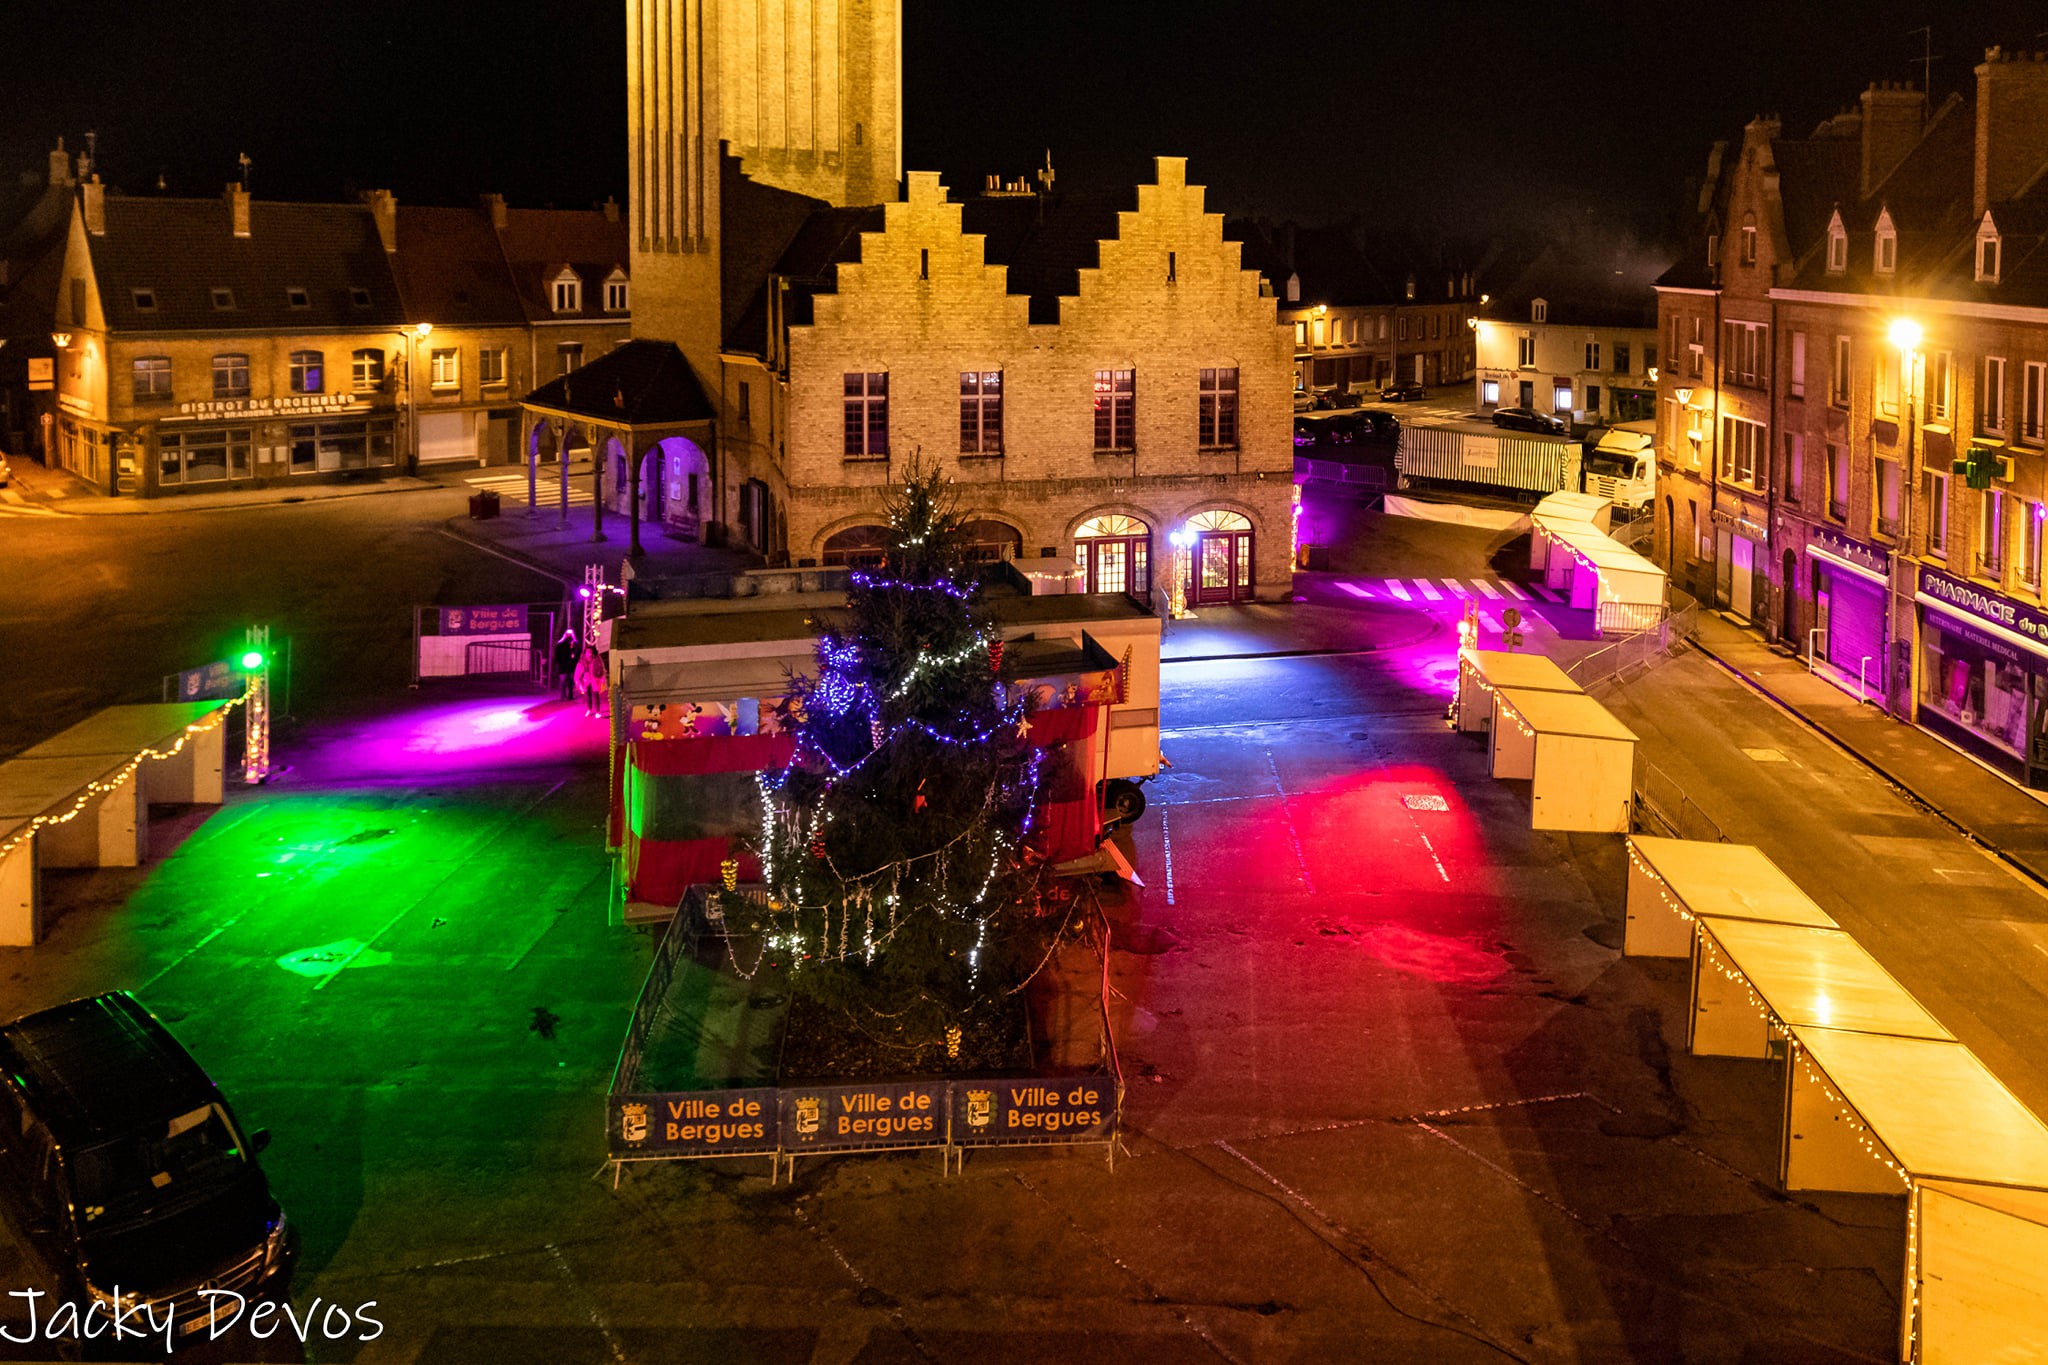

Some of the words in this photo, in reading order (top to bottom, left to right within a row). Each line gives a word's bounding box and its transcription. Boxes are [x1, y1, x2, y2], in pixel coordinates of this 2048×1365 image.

[181, 401, 243, 413] BISTROT
[249, 399, 269, 409] DU
[472, 610, 498, 618] Ville
[502, 608, 518, 618] de
[1925, 573, 2016, 625] PHARMACIE
[2018, 617, 2037, 635] du
[469, 618, 520, 631] Bergues
[1991, 641, 2018, 661] MEDICAL
[841, 1093, 892, 1113] Ville
[899, 1091, 931, 1110] de
[1011, 1088, 1060, 1107] Ville
[1067, 1087, 1099, 1105] de
[667, 1100, 720, 1119] Ville
[727, 1098, 761, 1116] de
[1009, 1107, 1101, 1130] Bergues
[667, 1120, 763, 1143] Bergues
[838, 1113, 933, 1137] Bergues
